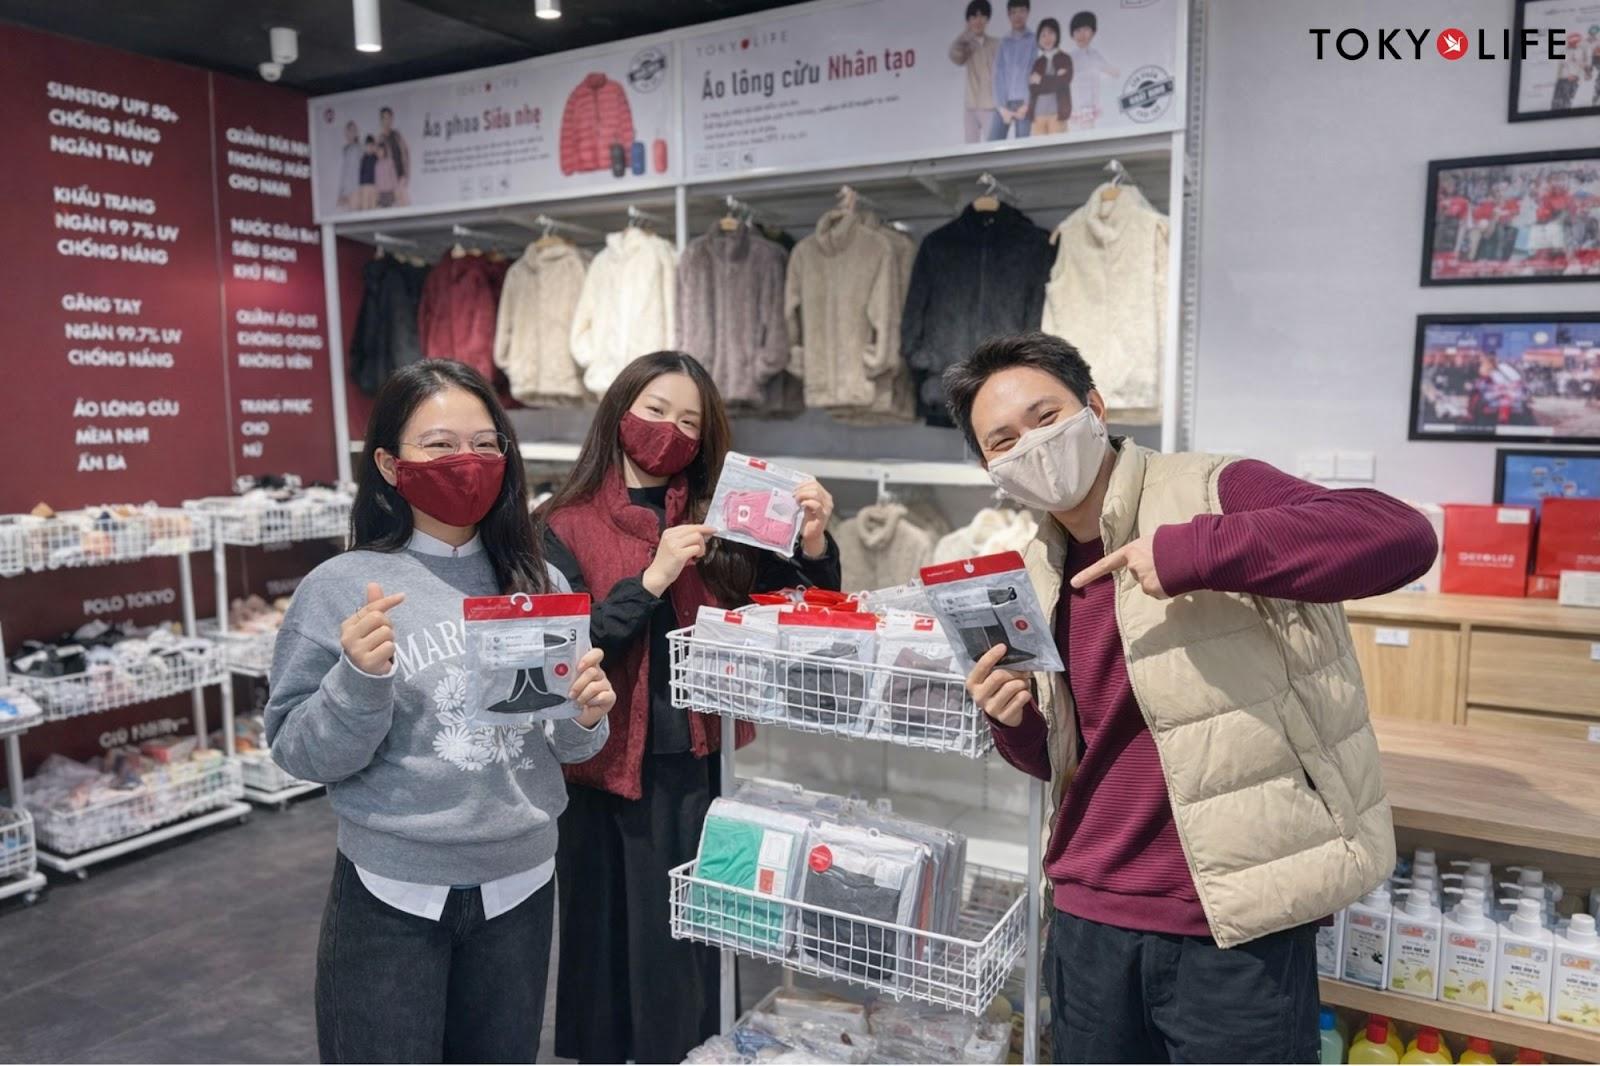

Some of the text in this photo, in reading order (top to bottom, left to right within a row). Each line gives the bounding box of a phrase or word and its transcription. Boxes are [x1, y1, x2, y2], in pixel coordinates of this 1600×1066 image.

[732, 69, 775, 97] lông
[828, 50, 878, 81] Nhân
[884, 48, 916, 77] tạo
[113, 298, 142, 315] TAY
